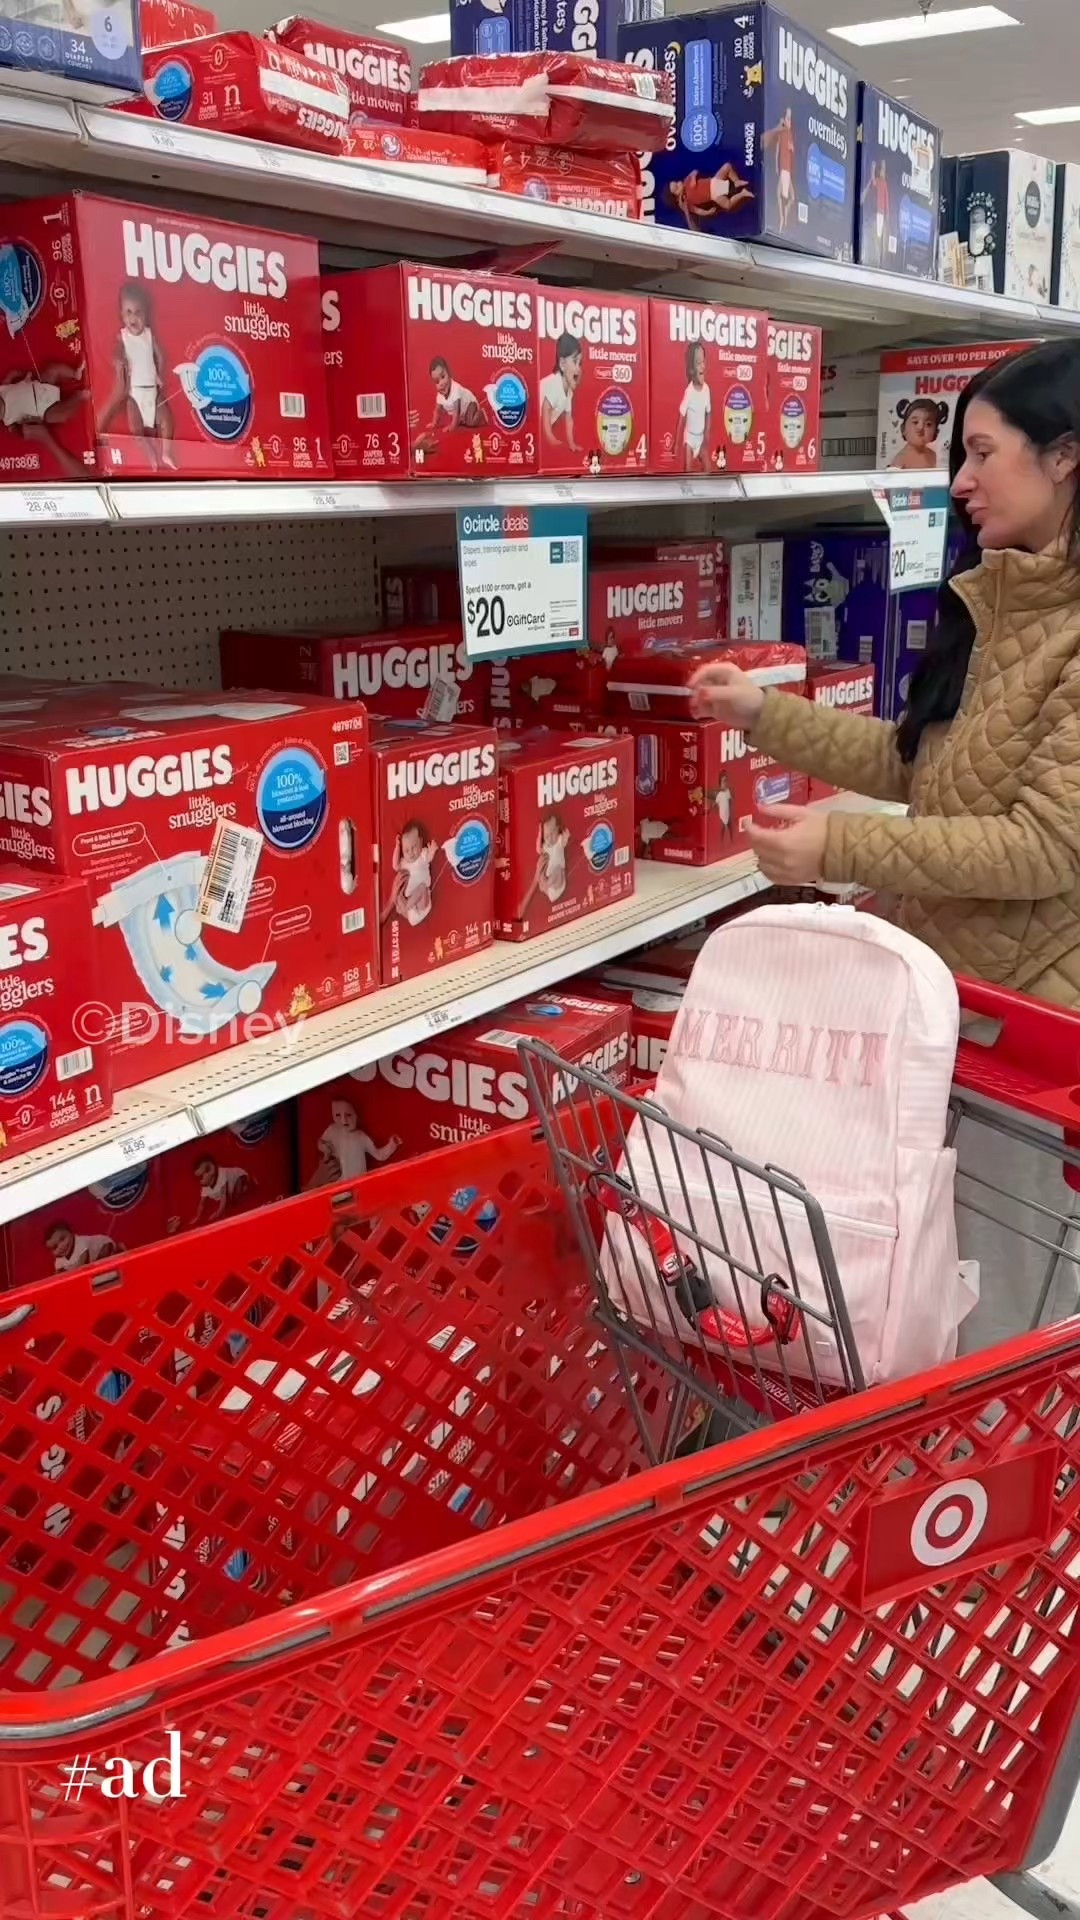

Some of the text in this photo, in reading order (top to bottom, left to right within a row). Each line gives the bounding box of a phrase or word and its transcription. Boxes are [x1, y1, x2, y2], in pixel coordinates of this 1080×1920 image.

[104, 15, 113, 32] 6
[734, 15, 749, 29] 4
[71, 39, 86, 54] 34
[304, 43, 411, 93] HUGGIES
[779, 27, 848, 119] HUGGIES
[203, 92, 214, 105] 31
[123, 220, 287, 299] HUGGIES
[243, 300, 266, 318] little
[408, 276, 532, 330] HUGGIES
[224, 313, 291, 342] snugglers
[669, 304, 757, 349] HUGGIES
[498, 333, 515, 345] little
[482, 342, 533, 363] snugglers
[589, 347, 609, 361] little
[906, 356, 929, 366] SAVE
[930, 354, 954, 364] OVER
[969, 351, 987, 361] PER
[208, 368, 231, 382] 100%
[614, 368, 630, 381] 360
[293, 437, 307, 452] 96
[314, 437, 324, 461] 1
[364, 434, 380, 449] 76
[388, 432, 400, 457] 3
[525, 433, 535, 456] 3
[635, 433, 647, 459] 4
[757, 431, 766, 455] 5
[808, 438, 817, 459] 6
[26, 501, 57, 512] 28.49
[473, 514, 529, 532] circle deals
[466, 585, 480, 594] Spend
[501, 583, 517, 591] more,
[607, 580, 684, 619] HUGGIES
[467, 595, 506, 638] $20
[513, 612, 546, 626] GiftCard
[638, 614, 684, 630] little movers
[333, 641, 474, 699] HUGGIES
[815, 675, 873, 708] HUGGIES
[720, 728, 758, 763] HU
[65, 744, 234, 816] HUGGIES
[276, 773, 303, 788] 100%
[387, 744, 496, 801] HUGGIES
[537, 757, 618, 808] HUGGIES
[0, 781, 52, 827] IES
[188, 794, 212, 811] little
[448, 788, 495, 812] snugglers
[168, 800, 237, 830] snugglers
[10, 825, 31, 841] little
[342, 968, 359, 982] 168
[537, 993, 618, 1013] HUGGIES
[674, 1008, 888, 1086] MERRITT
[49, 1089, 76, 1110] 144
[84, 1084, 102, 1106] n
[49, 1111, 79, 1129] COUCHES
[51, 1104, 77, 1120] DIAPERS
[459, 1113, 491, 1135] little
[123, 1139, 145, 1154] 44.99
